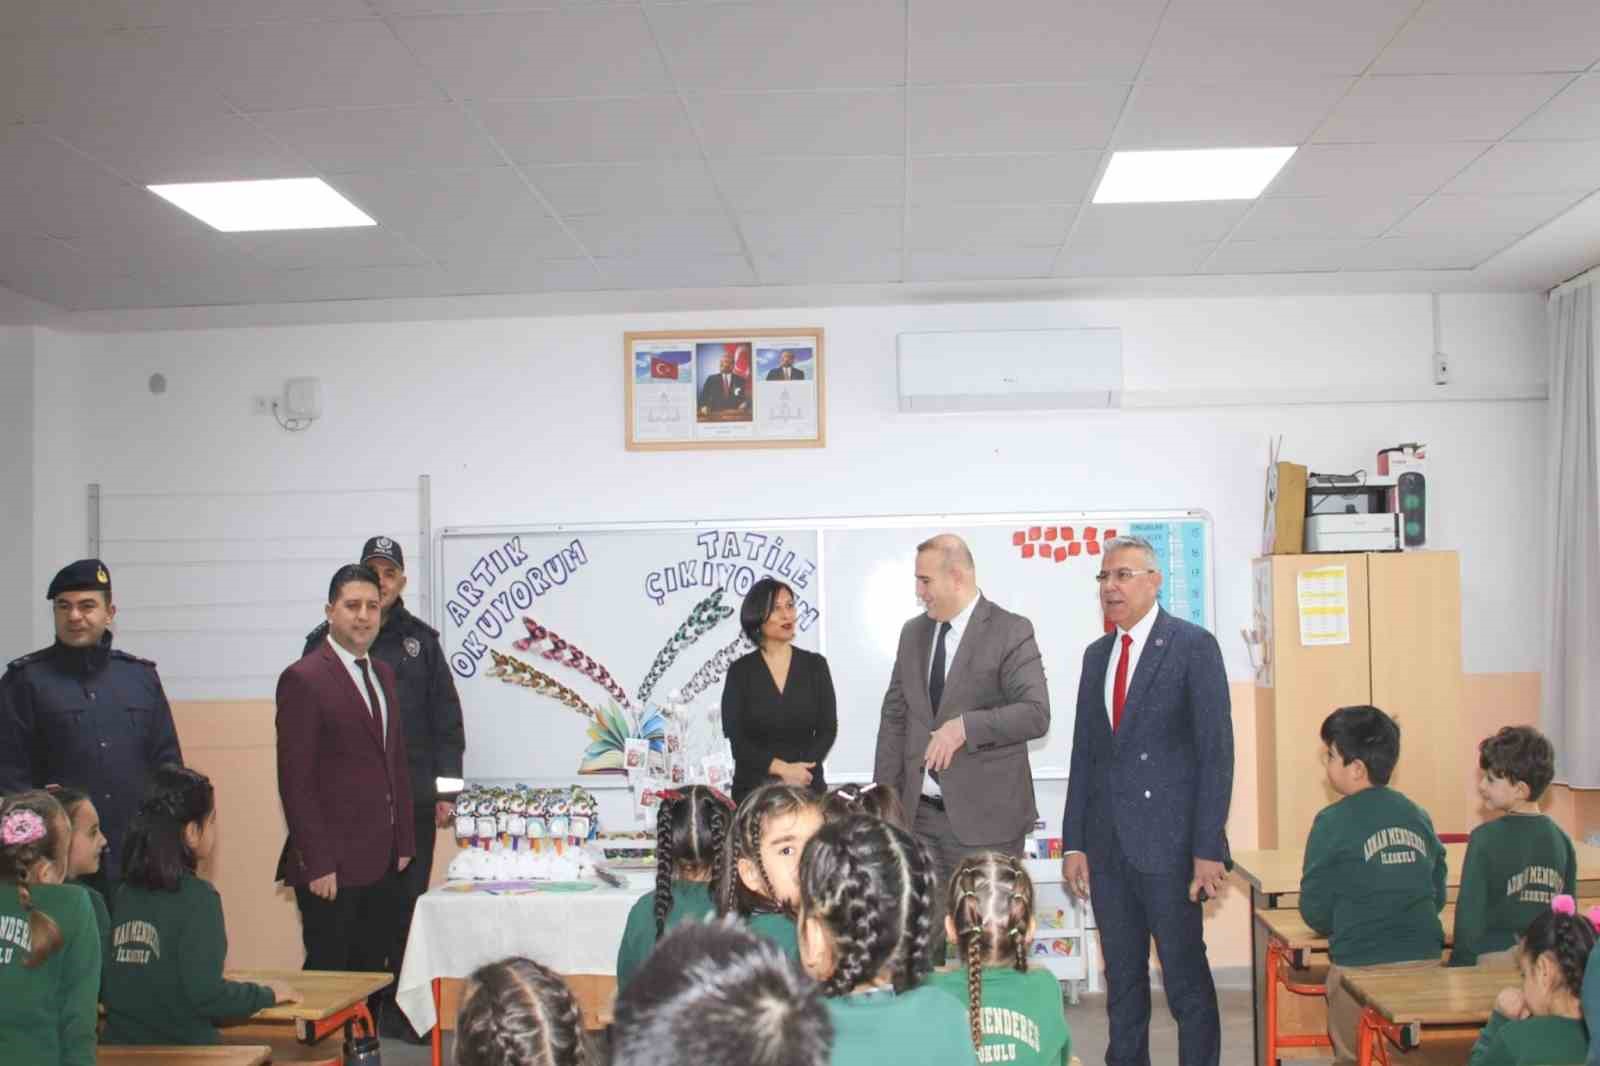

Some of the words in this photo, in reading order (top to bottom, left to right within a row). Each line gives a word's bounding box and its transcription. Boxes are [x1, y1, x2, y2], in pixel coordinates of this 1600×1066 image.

[446, 535, 528, 628] ARTIK
[645, 559, 820, 632] ÇIKIYOM
[697, 530, 816, 589] TATİLE
[450, 539, 589, 678] OKUYORUM
[976, 1043, 1016, 1064] OKULU
